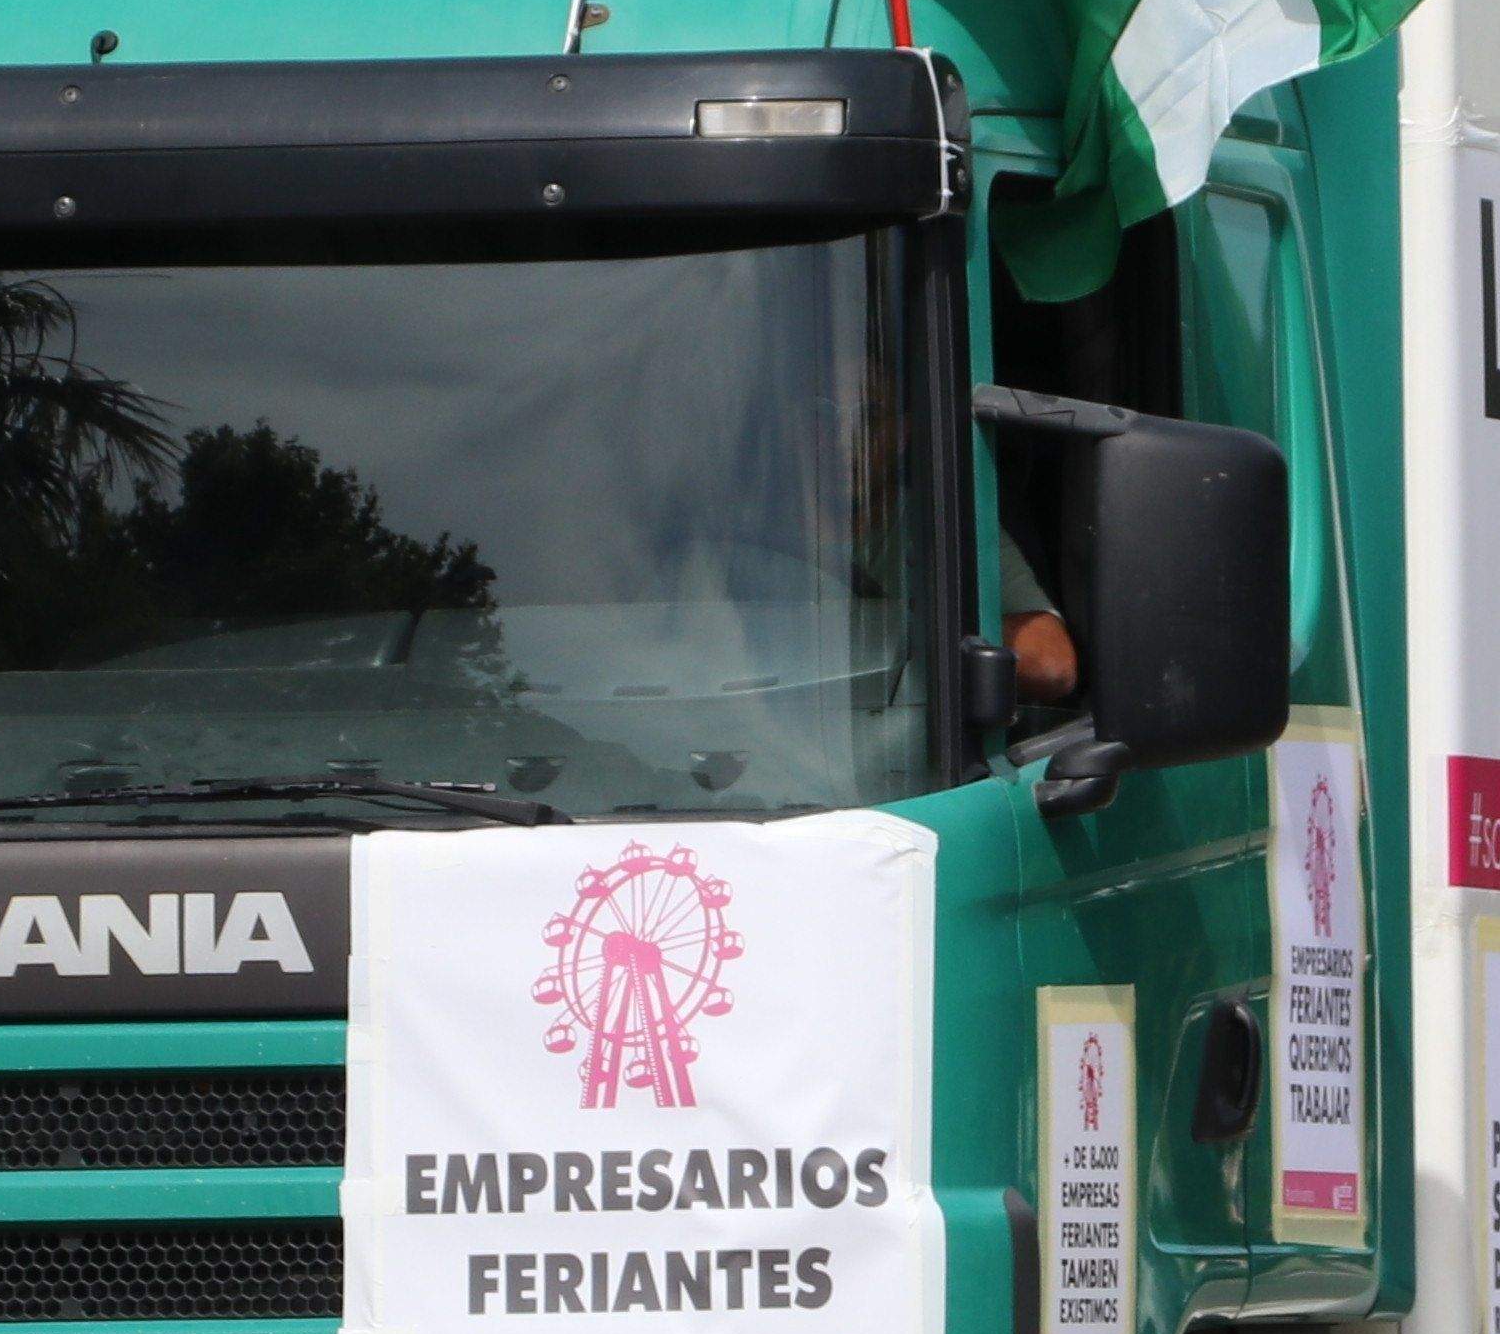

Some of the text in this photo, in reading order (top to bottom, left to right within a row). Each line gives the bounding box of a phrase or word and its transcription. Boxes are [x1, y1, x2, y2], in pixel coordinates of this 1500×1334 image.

[1289, 984, 1351, 1027] FERIANTES
[1289, 1033, 1351, 1073] QUEREMOS
[1289, 1083, 1351, 1124] TRABAJAR
[1073, 1145, 1087, 1169] DE
[404, 1147, 889, 1216] EMPRESARIOS
[1061, 1181, 1120, 1208] EMPRESAS
[1061, 1221, 1119, 1249] FERIANTES
[467, 1247, 834, 1315] FERIANTES
[1059, 1298, 1119, 1324] EXISTIMOS
